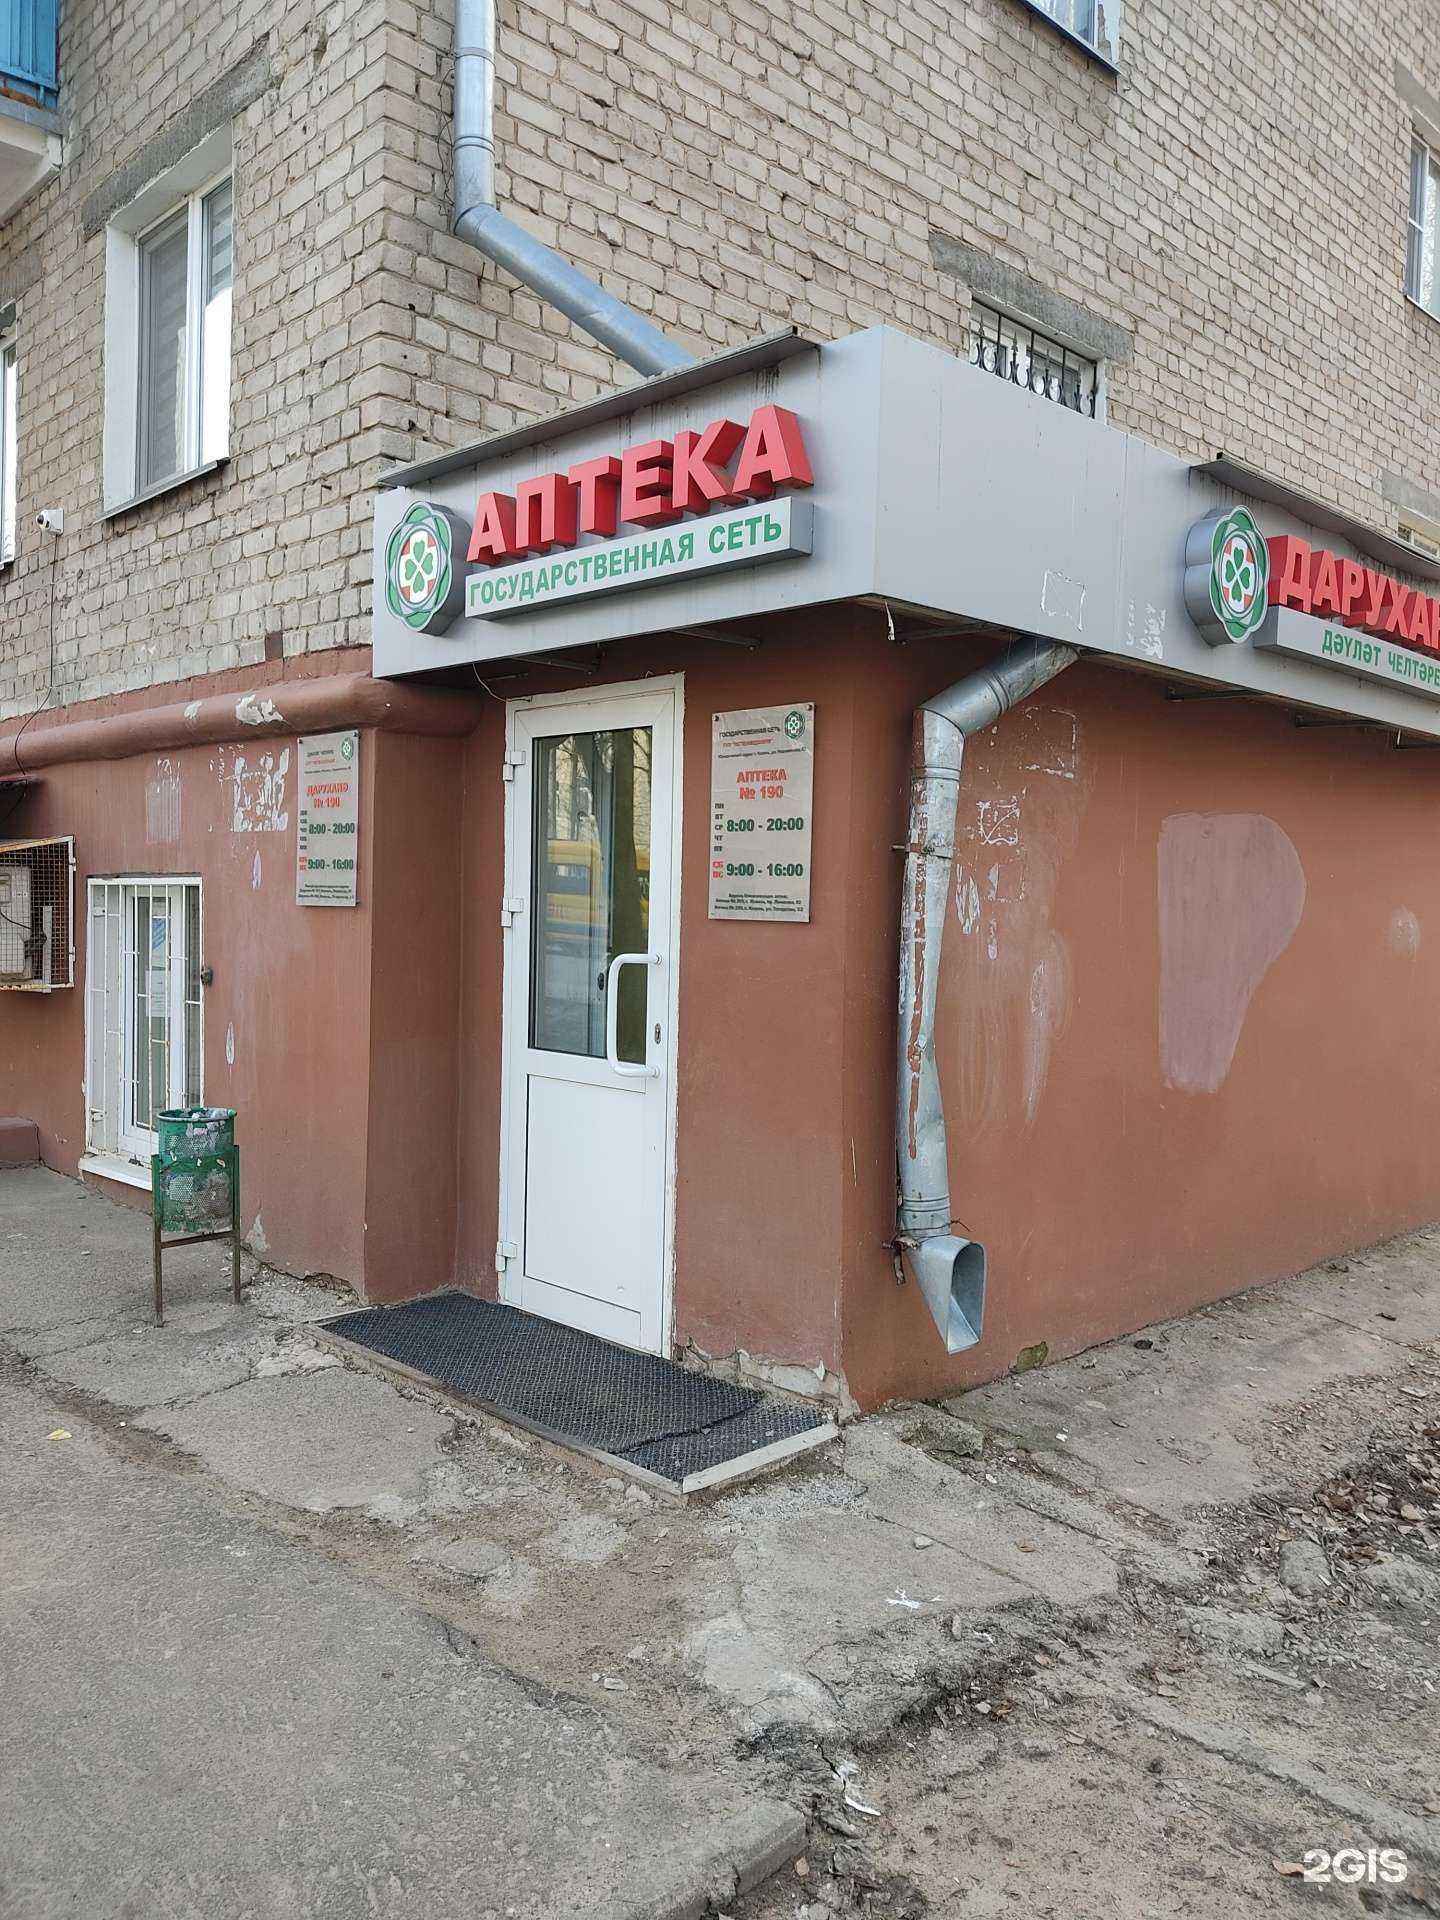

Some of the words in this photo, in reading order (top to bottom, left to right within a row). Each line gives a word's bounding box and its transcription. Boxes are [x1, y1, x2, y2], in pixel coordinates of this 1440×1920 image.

[465, 404, 812, 567] АПТЕКА
[469, 532, 695, 608] ГОСУДАРСТВЕННАЯ
[708, 512, 783, 556] СЕТЬ
[736, 768, 788, 783] АПТЕКА
[739, 787, 756, 800] №
[760, 785, 784, 799] 190
[308, 823, 327, 834] 8:00
[332, 822, 355, 834] 20:00
[726, 819, 755, 832] 8:00
[766, 817, 804, 831] 20:00
[307, 858, 326, 870] 9:00
[332, 858, 354, 870] 16:00
[726, 863, 755, 876] 9:00
[766, 863, 804, 877] 16:00
